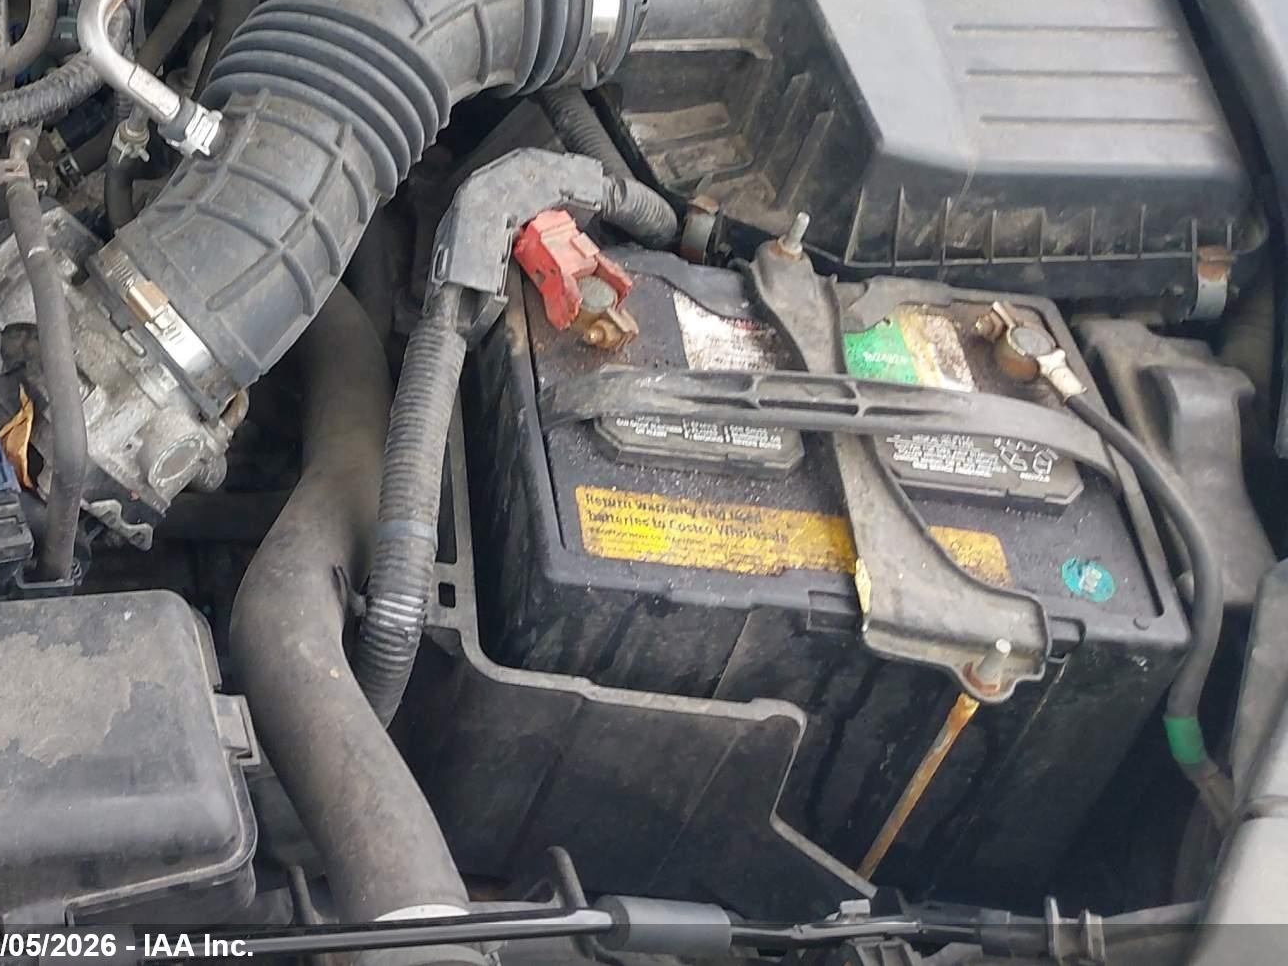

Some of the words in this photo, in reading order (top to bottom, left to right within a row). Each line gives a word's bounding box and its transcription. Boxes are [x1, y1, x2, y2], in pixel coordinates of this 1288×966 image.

[585, 492, 632, 509] Return
[635, 498, 697, 518] warranty
[588, 510, 650, 528] batteries
[653, 518, 666, 530] to
[669, 519, 712, 535] Costco
